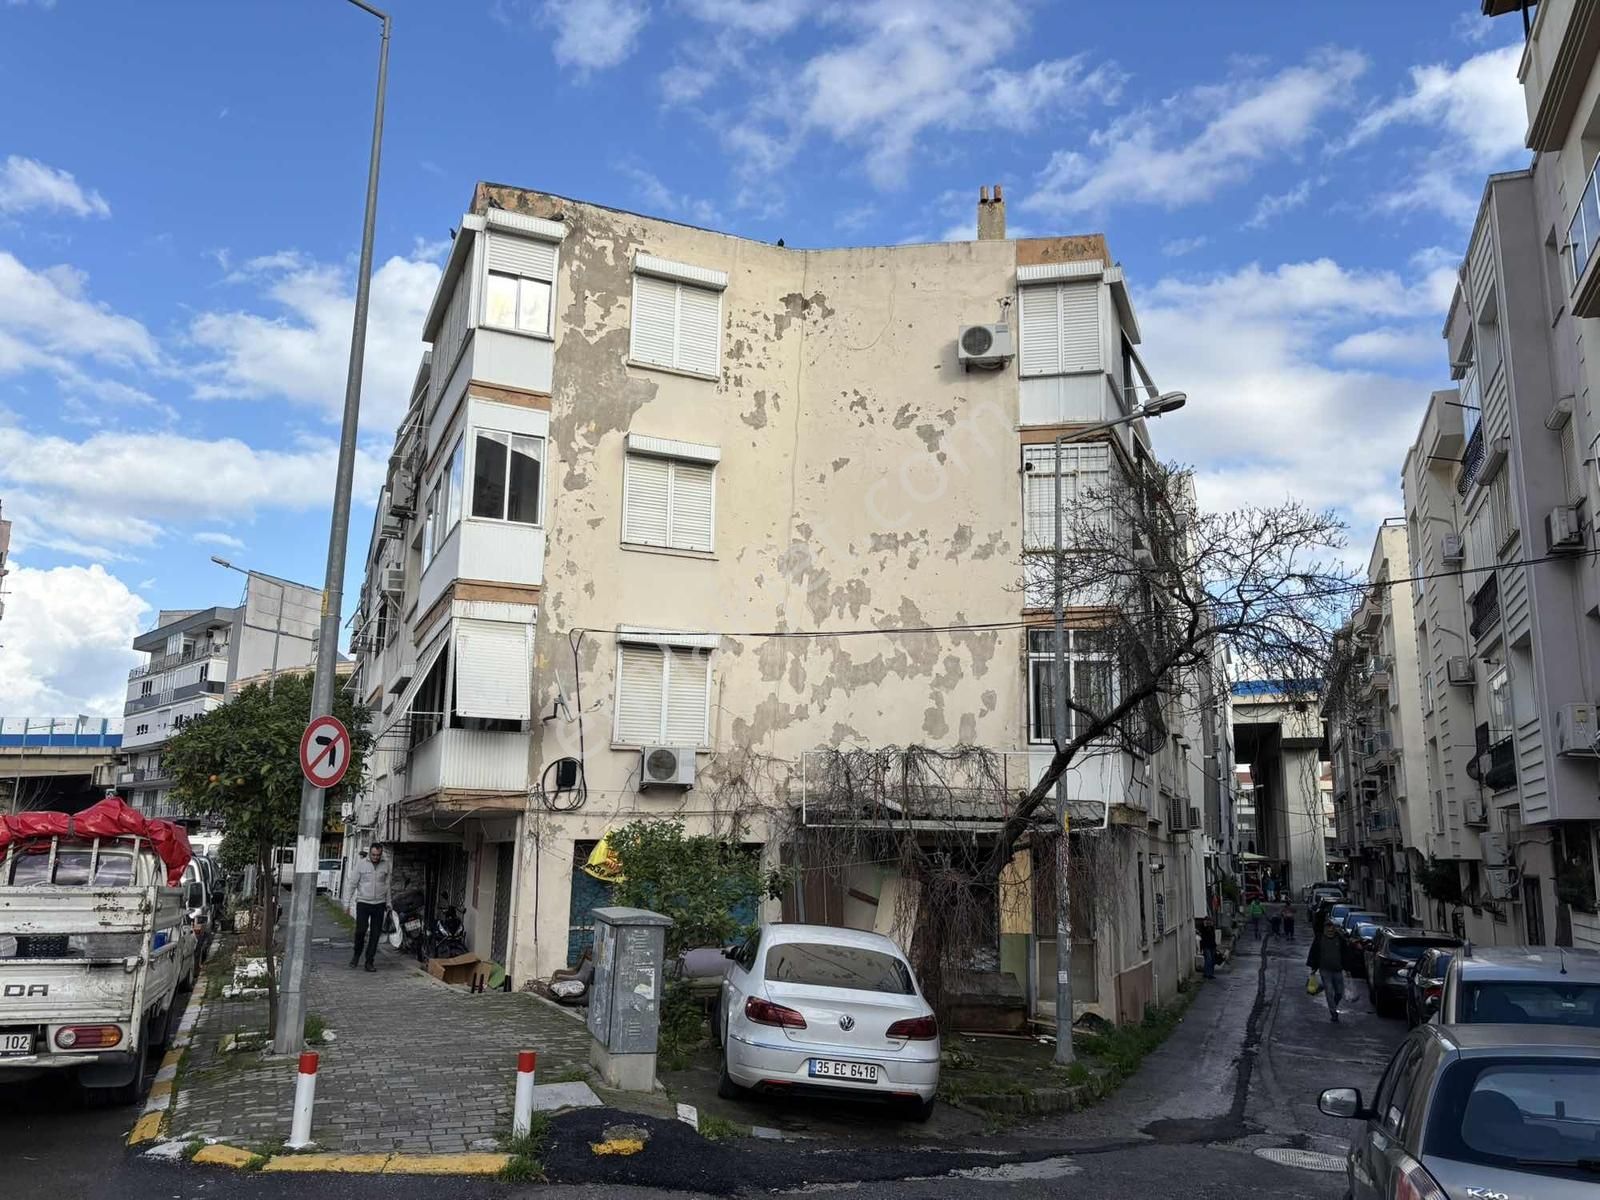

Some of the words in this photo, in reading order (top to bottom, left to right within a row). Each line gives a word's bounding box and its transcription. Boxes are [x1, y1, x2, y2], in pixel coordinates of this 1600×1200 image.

[5, 1036, 28, 1049] 102
[817, 1061, 829, 1074] 35
[834, 1063, 847, 1076] EC
[851, 1065, 876, 1079] 6418
